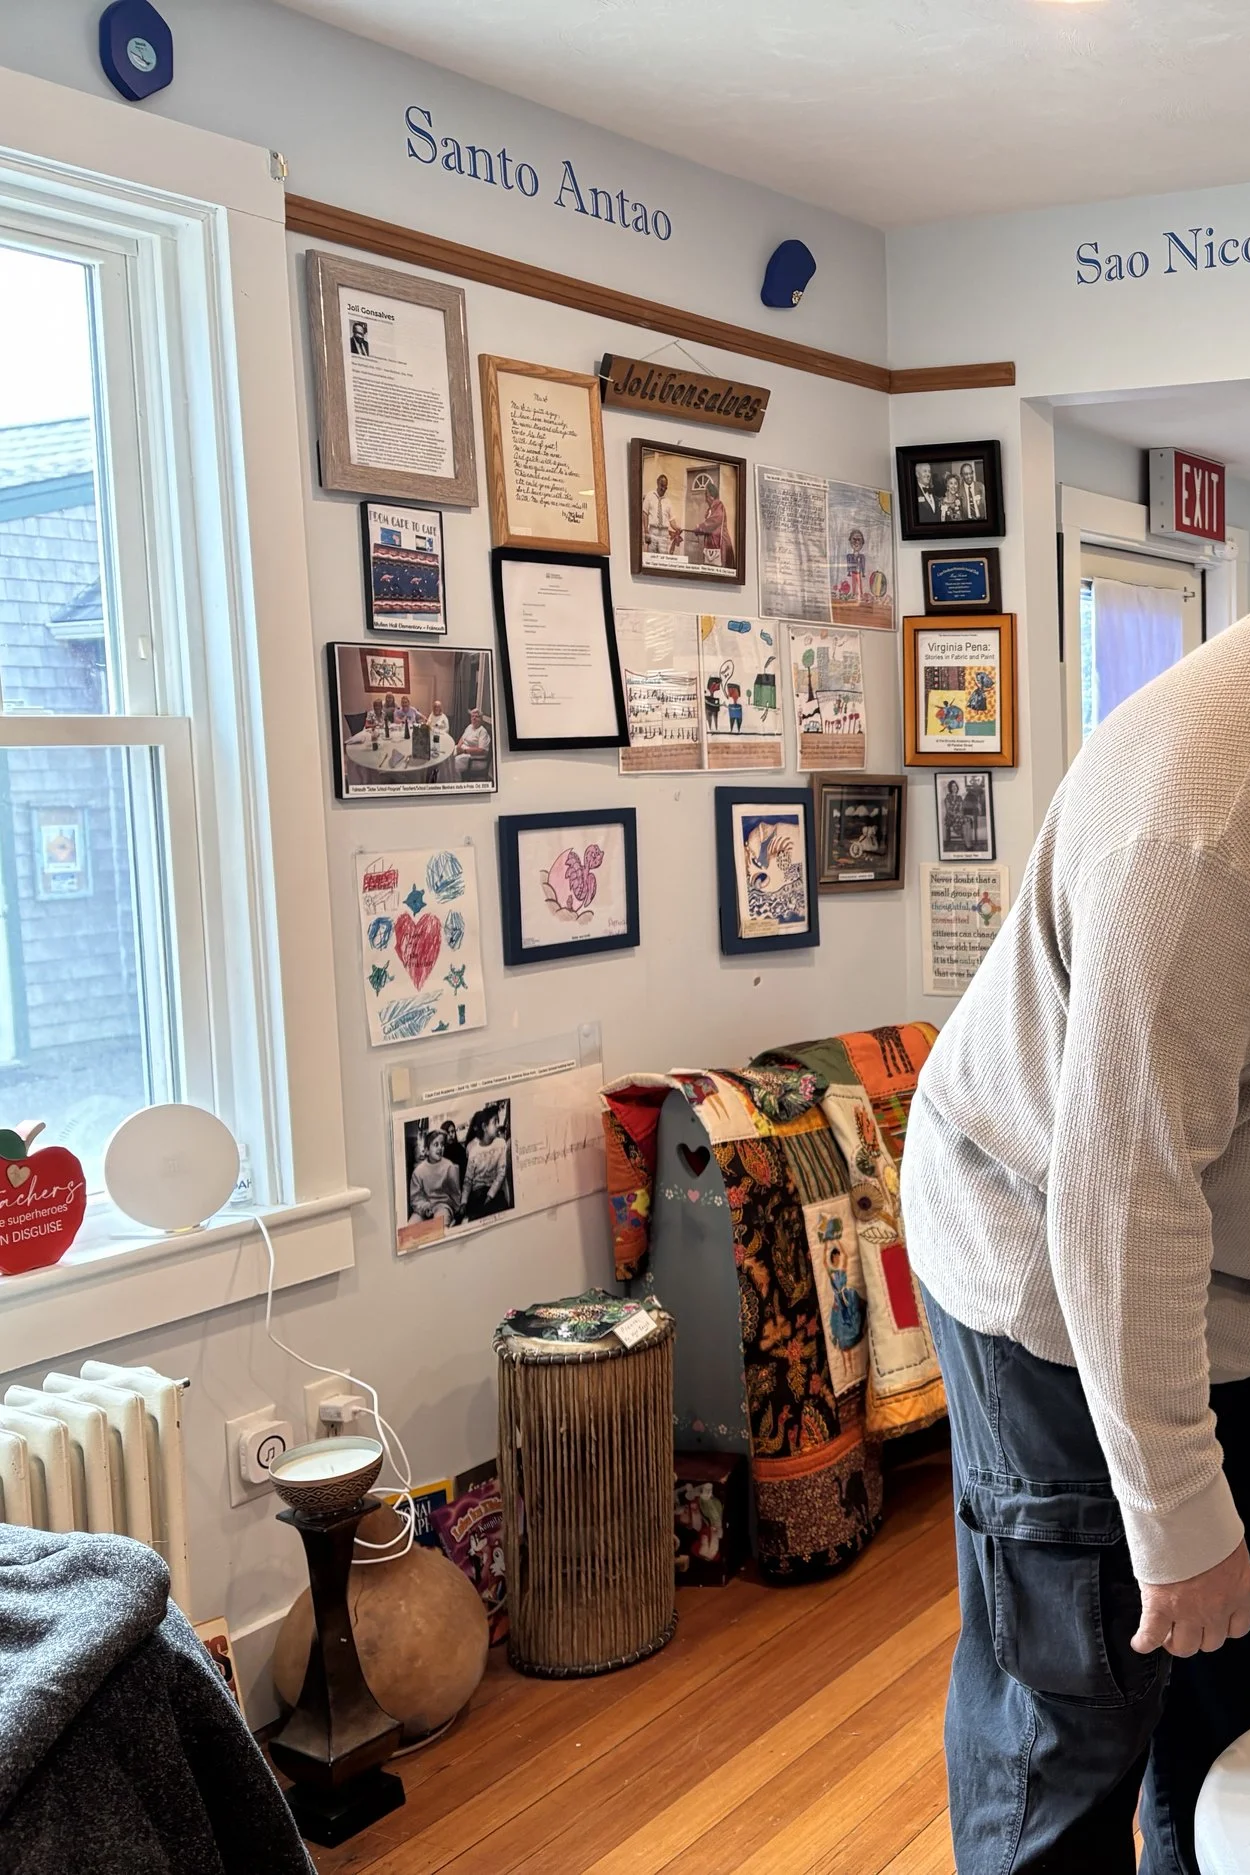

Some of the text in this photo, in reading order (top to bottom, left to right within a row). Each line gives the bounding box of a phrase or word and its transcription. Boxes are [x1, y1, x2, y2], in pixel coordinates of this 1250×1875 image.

[405, 106, 672, 241] Santo Antao
[1076, 242, 1149, 285] Sao
[347, 304, 360, 313] Joli
[361, 307, 395, 321] Gonsalves
[1181, 463, 1219, 533] EXIT
[369, 511, 438, 536] FROM CAPE TO CAPE
[928, 642, 991, 654] Virginia Pena:
[930, 874, 952, 884] Never
[953, 873, 975, 884] doubt
[976, 874, 990, 884] that
[931, 888, 980, 899] small group of
[932, 929, 958, 938] citizens
[933, 942, 945, 951] the
[947, 956, 959, 964] the
[934, 968, 949, 978] that
[7, 1203, 68, 1228] superheroes
[12, 1220, 63, 1243] DISGUISE
